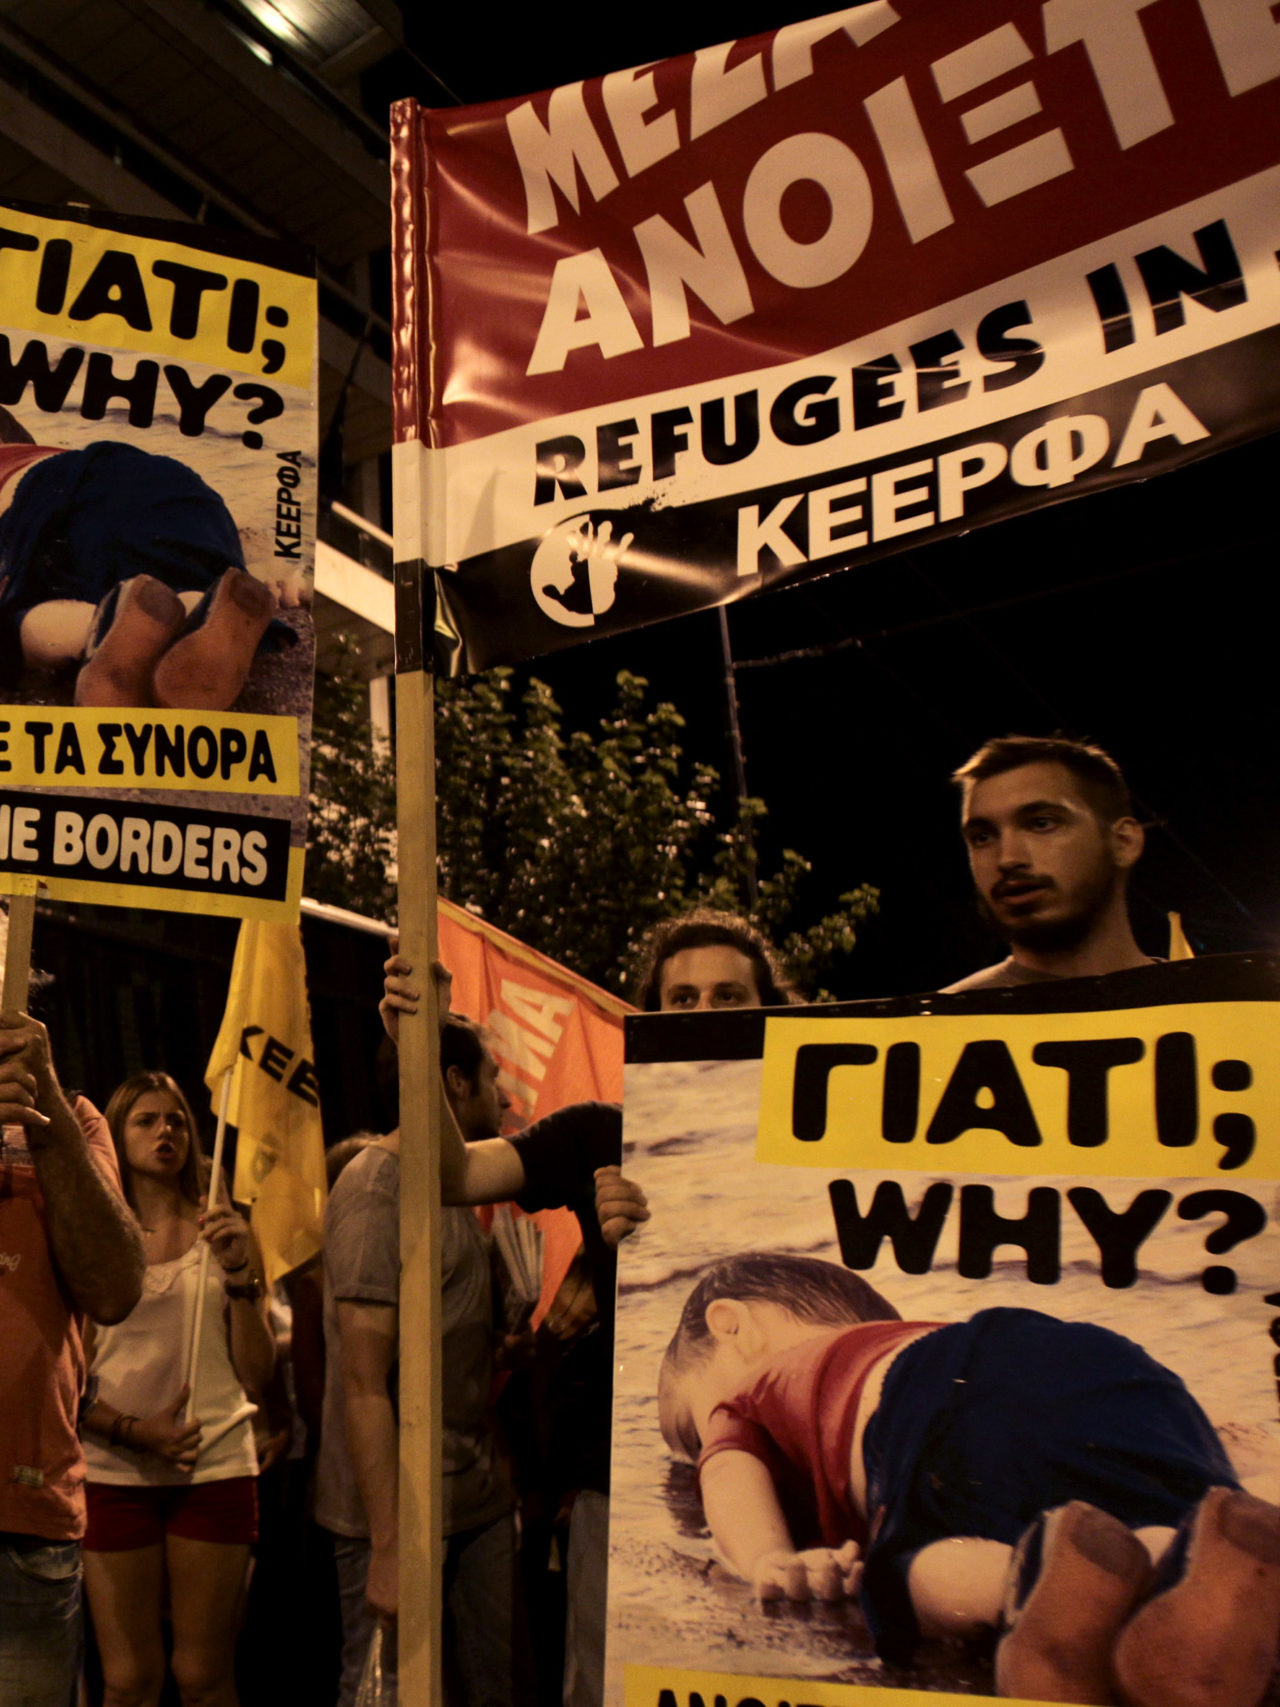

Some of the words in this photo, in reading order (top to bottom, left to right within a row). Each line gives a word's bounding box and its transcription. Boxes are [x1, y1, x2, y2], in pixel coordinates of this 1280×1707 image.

[533, 299, 1046, 506] REFUGEES
[1085, 218, 1248, 354] IN
[274, 450, 302, 559] ΚΕΕΡΦΑ
[736, 382, 1211, 577] ΚΕΕΡΦΑ
[25, 720, 86, 775] ΤΑ
[97, 722, 278, 784] ΣΥΝΟΡΑ
[52, 810, 268, 886] BORDERS
[792, 1031, 1257, 1171] ΓΙΑΤΙ;
[828, 1178, 1268, 1295] WHY?
